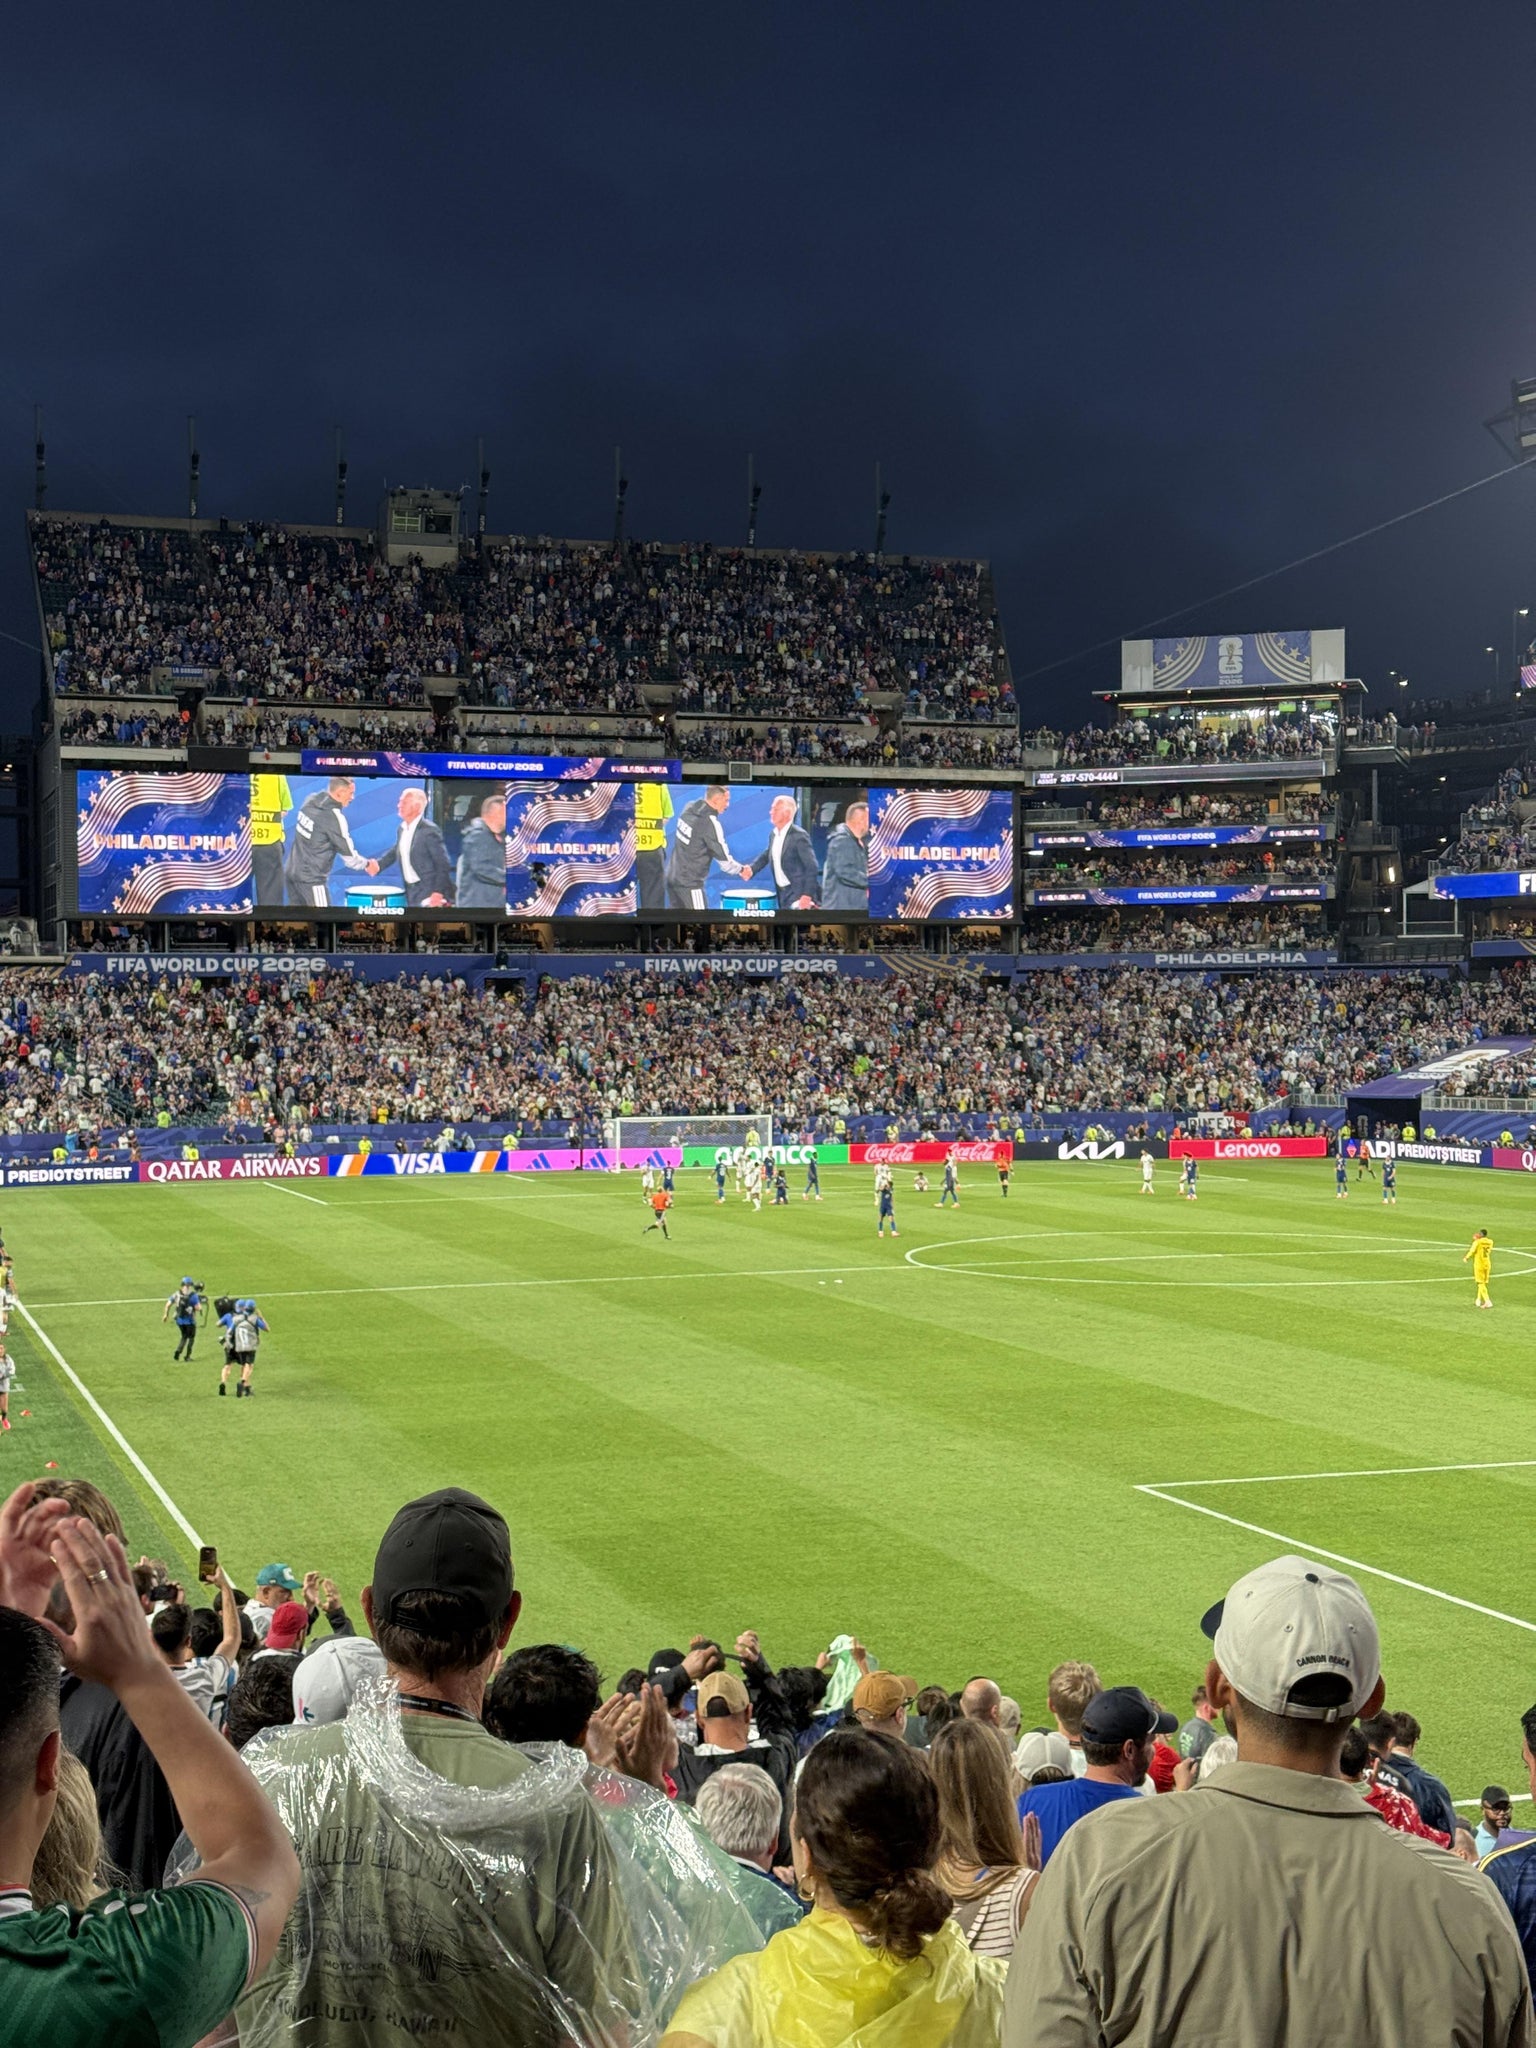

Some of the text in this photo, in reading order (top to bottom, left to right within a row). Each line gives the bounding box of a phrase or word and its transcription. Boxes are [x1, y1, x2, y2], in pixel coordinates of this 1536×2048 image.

[316, 757, 377, 767] PHILADELPHIA
[447, 761, 544, 772] FIFA WORLD CUP 2026
[610, 765, 668, 775] PHILADELPHIA
[1060, 772, 1118, 783] 267-570-4444
[93, 833, 238, 850] PHILADELPHIA
[1137, 832, 1216, 842] FIFA WORLD CUP 2026
[523, 842, 620, 855] PHILADELPHIA
[880, 846, 1000, 861] PHILADELPHIA
[1138, 892, 1153, 900] FIFA
[1153, 892, 1180, 900] WORLD
[1192, 891, 1217, 899] 2026
[358, 905, 405, 915] Hisense
[733, 908, 776, 918] Hisense
[107, 957, 327, 972] FIFA WORLD CUP 2026
[1155, 951, 1307, 965] PHILADELPHIA
[645, 958, 838, 973] FIFA WORLD CUP 2026
[1058, 1141, 1125, 1160] KIA
[1214, 1141, 1281, 1158] Lenovo
[1397, 1143, 1482, 1164] PREDICTSTREET
[387, 1153, 446, 1175] VISA
[1521, 1151, 1536, 1172] Q
[8, 1166, 132, 1184] PREDICTSTREET
[147, 1157, 321, 1182] QATAR AIRWAYS
[1296, 1654, 1350, 1668] CANNON BEACH
